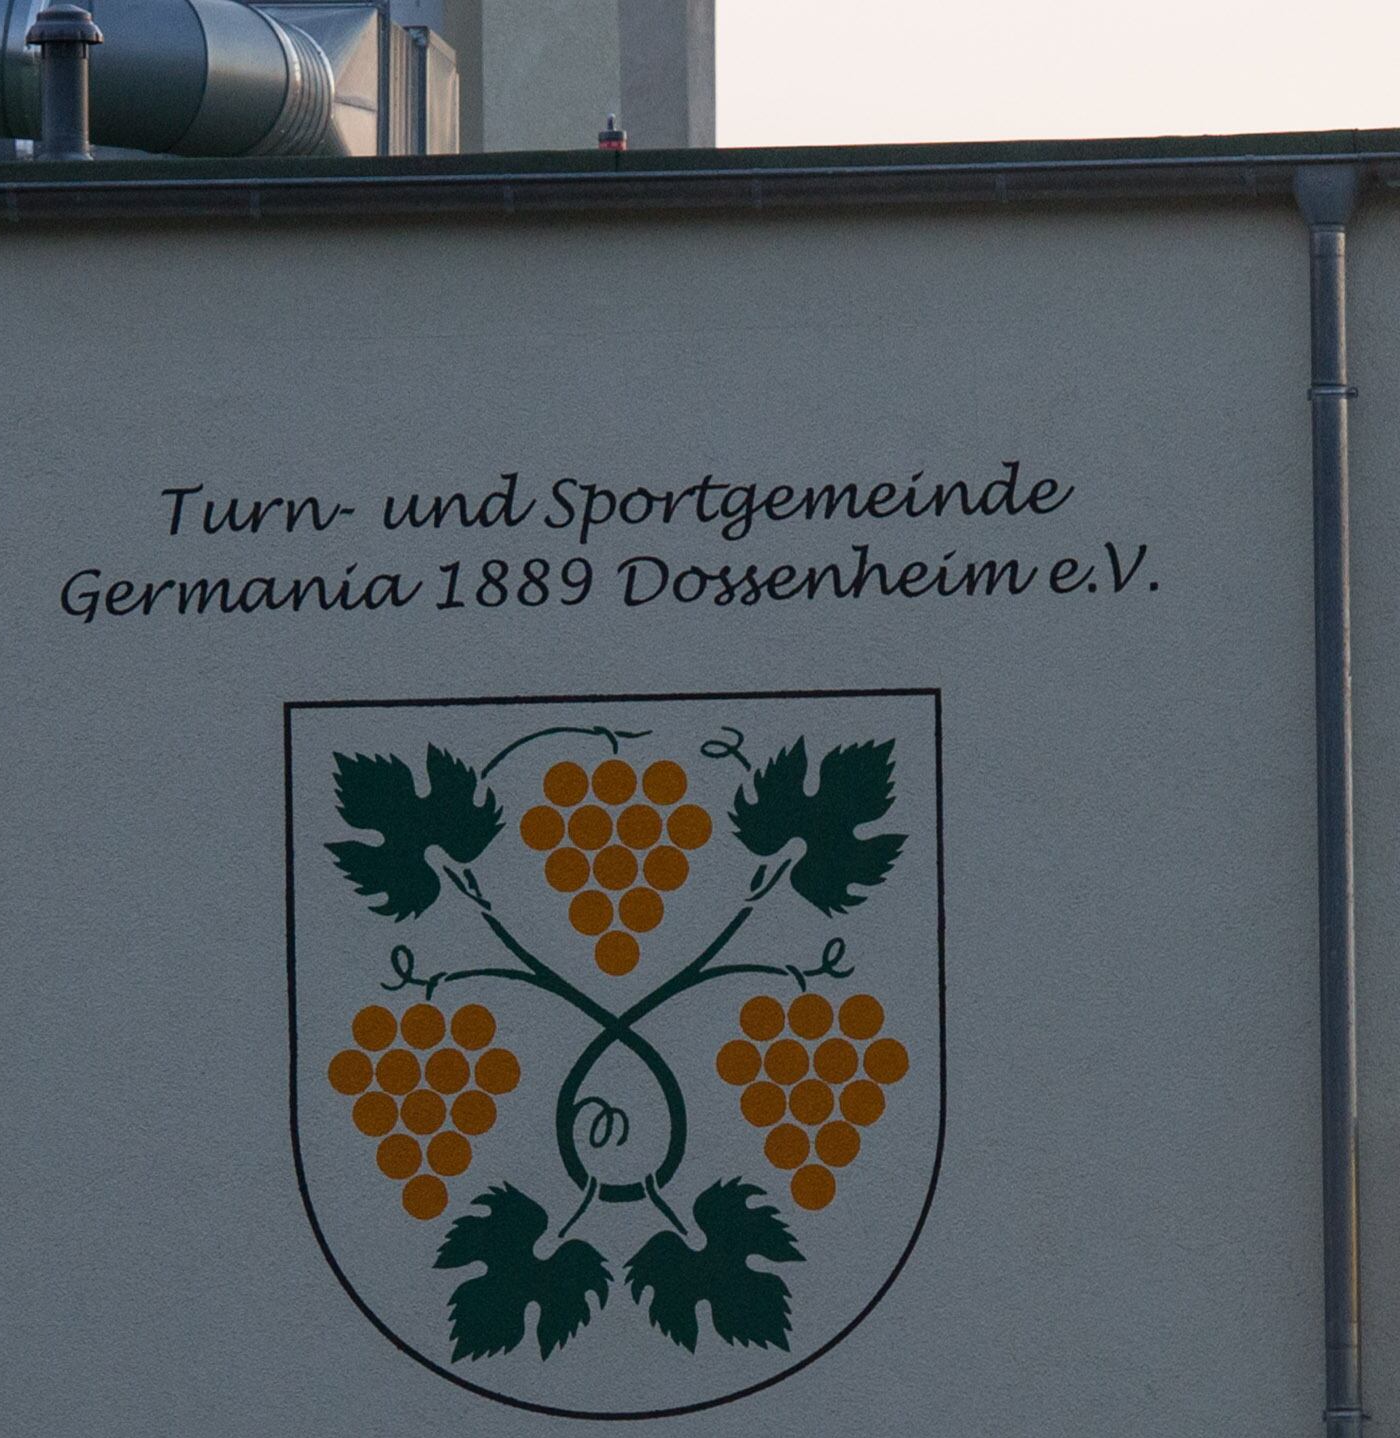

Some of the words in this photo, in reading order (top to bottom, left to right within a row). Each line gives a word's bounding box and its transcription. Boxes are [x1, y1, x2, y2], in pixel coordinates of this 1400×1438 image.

[160, 482, 356, 537] Turn-
[382, 471, 538, 533] und
[542, 459, 1076, 545] Sportgemeinde
[59, 559, 425, 625] Germania
[434, 555, 594, 611] 1889
[615, 543, 1040, 608] Dossenheim
[1048, 540, 1160, 596] e.V.
